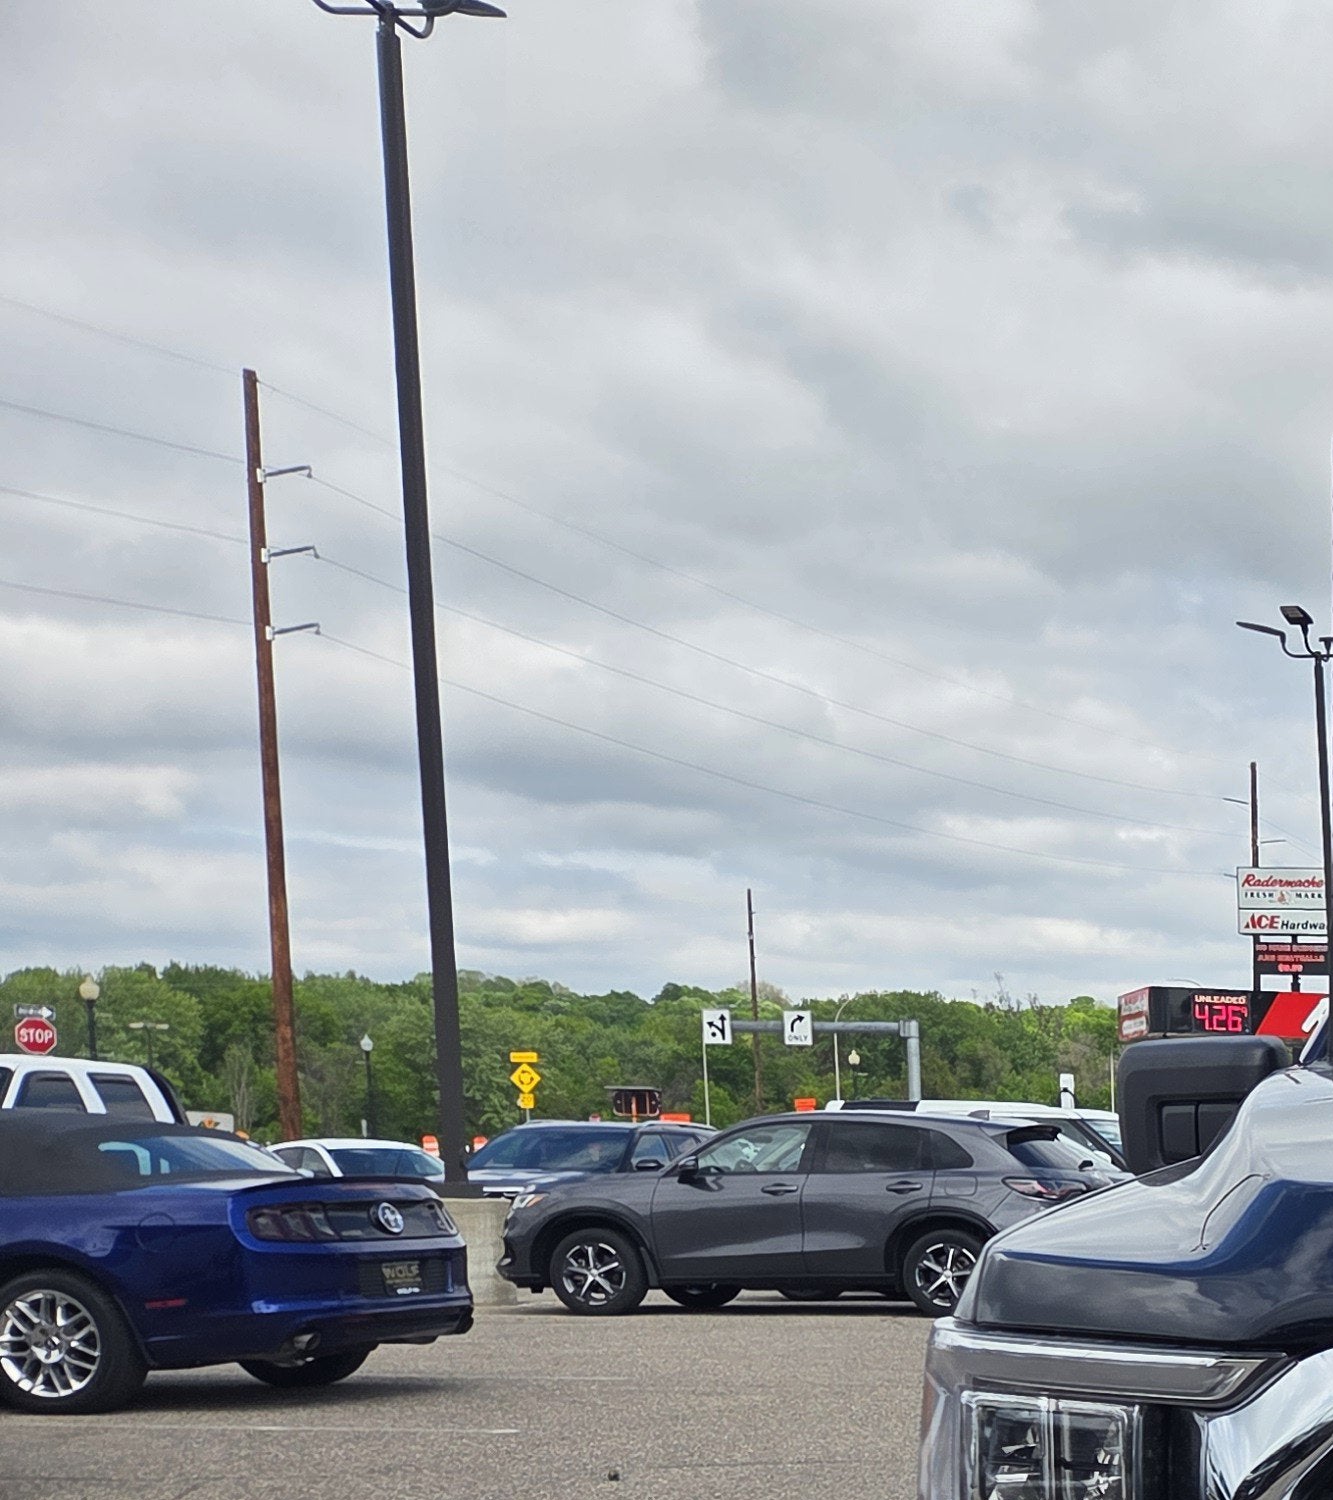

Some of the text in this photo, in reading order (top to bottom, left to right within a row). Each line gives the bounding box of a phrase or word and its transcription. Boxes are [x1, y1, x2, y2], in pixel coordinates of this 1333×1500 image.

[1242, 873, 1325, 889] Radermache
[1244, 913, 1326, 931] ACE Hardwa
[1194, 994, 1247, 1005] UNLEADED
[19, 1028, 53, 1044] STOP
